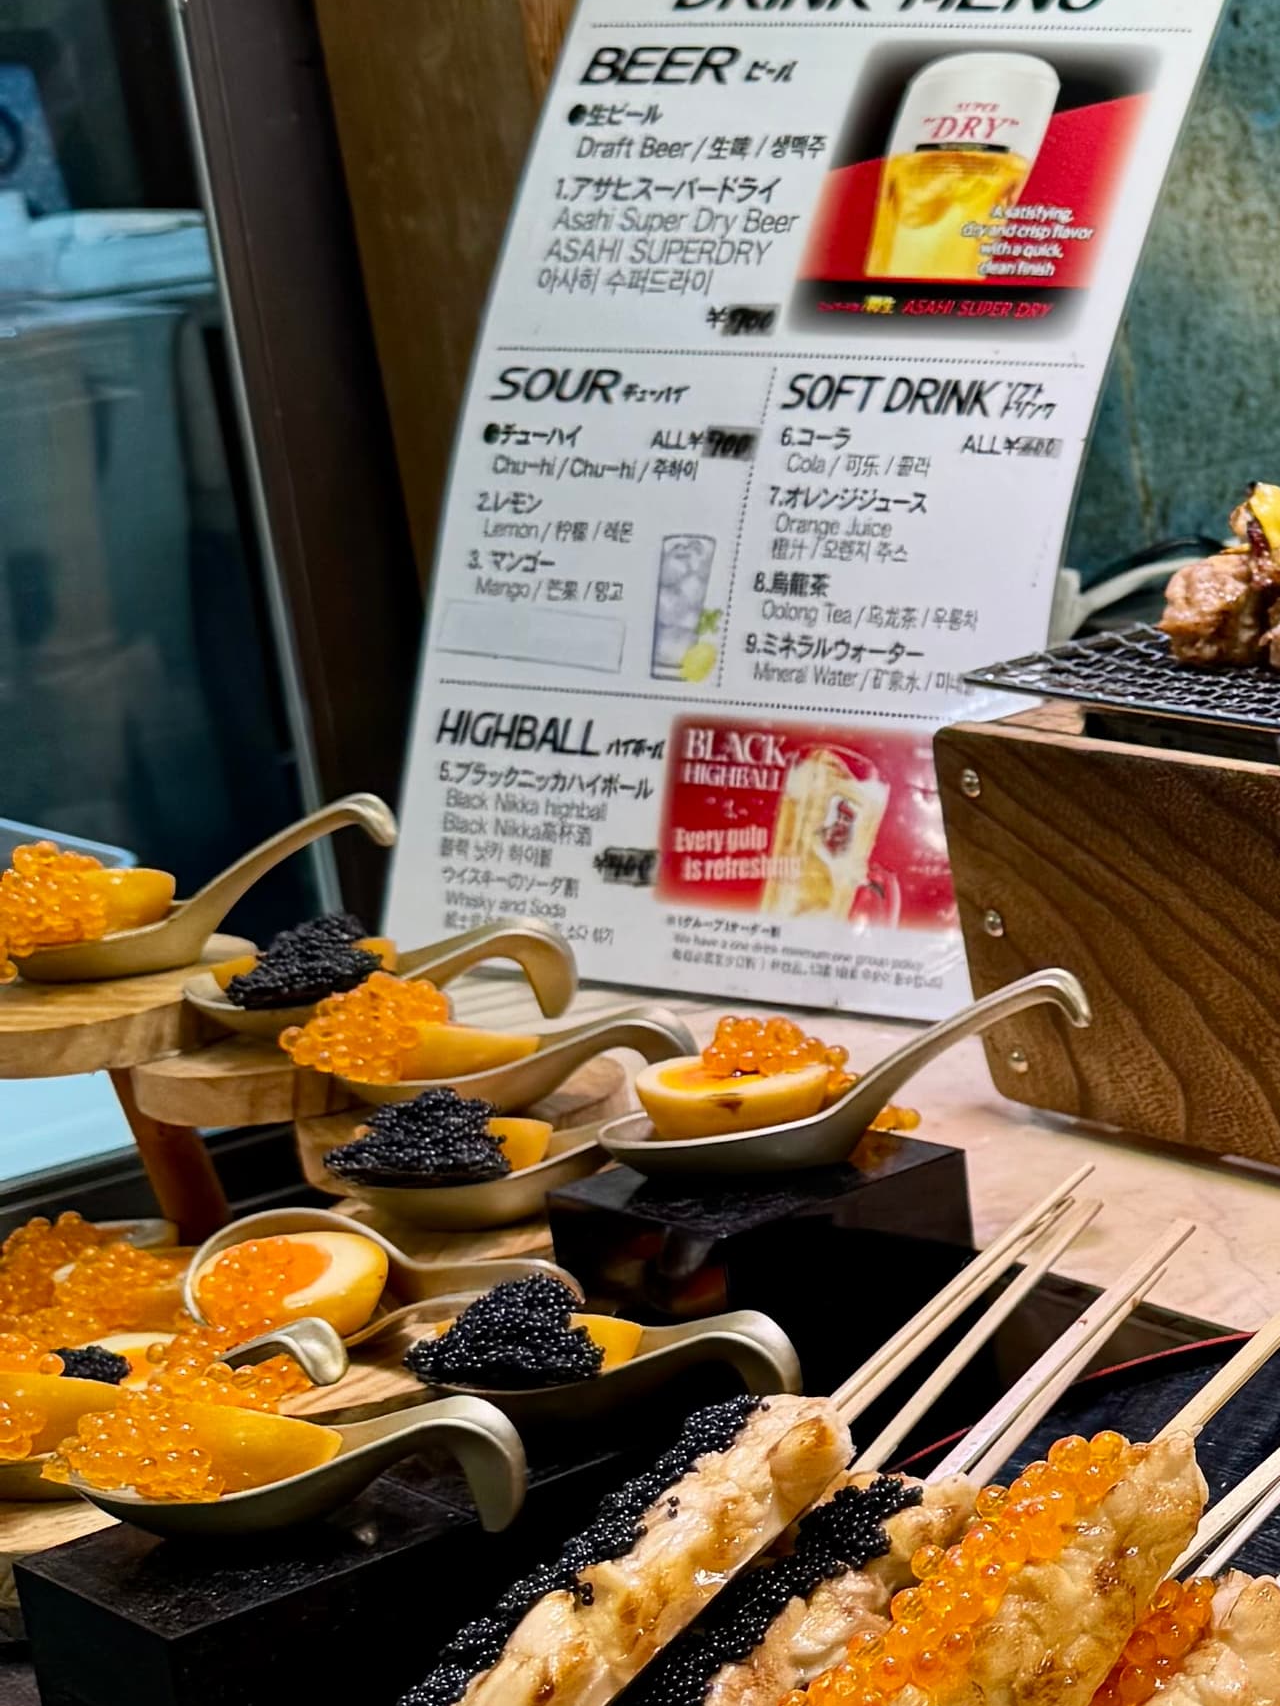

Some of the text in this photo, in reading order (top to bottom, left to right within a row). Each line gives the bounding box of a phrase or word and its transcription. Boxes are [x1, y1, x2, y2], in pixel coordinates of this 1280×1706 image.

[578, 45, 799, 86] BEER ビール
[585, 103, 664, 128] 生ビール
[575, 135, 828, 161] Draft Beer 생맥주
[552, 206, 801, 239] Asahi Super Dry Beer
[543, 238, 773, 267] ASAHI SUPERDRY
[536, 267, 715, 297] 아사히 수퍼드라이
[1016, 261, 1055, 277] finish
[901, 299, 1055, 320] ASAHI SUPER DRY
[488, 367, 692, 405] SOUR チューハイ
[780, 372, 1004, 418] SOFT DRINK
[500, 423, 584, 446] チューハイ
[780, 426, 853, 450] 6.コーラ
[491, 454, 558, 478] Chu-hi
[569, 457, 637, 480] Chu-hi
[786, 452, 826, 474] Cola
[845, 454, 881, 478] 可乐
[475, 490, 544, 515] 2.レモン
[769, 485, 928, 515] 7.オレンジジュース
[482, 518, 539, 540] Lemon
[774, 512, 893, 541] Orange Juice
[466, 549, 556, 574] 3. マンゴー
[875, 541, 910, 564] 주스
[474, 577, 531, 602] Mango
[752, 570, 832, 598] 8.烏龍茶
[761, 599, 819, 626] Oolong
[823, 602, 853, 625] Tea
[743, 633, 926, 666] 9.ミネラルウォーター
[753, 660, 858, 689] Mineral Water
[436, 708, 667, 760] HIGHBALL ハイボール
[684, 727, 787, 767] BLACK
[438, 760, 655, 801] 5.ブラックニッカハイボール
[682, 762, 781, 792] HIGHBALL
[445, 787, 608, 823] Black Nikka highball
[441, 811, 487, 835] Black
[673, 826, 726, 855] Every
[682, 856, 703, 882] is
